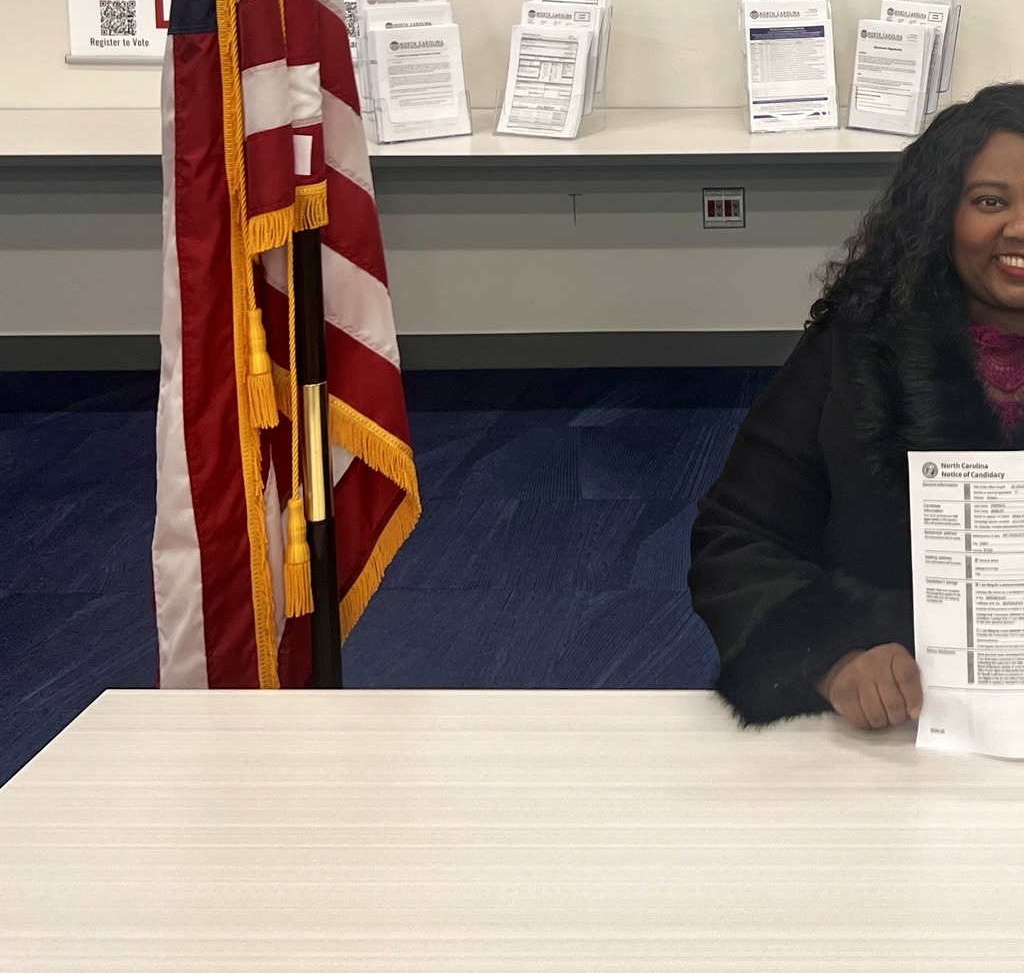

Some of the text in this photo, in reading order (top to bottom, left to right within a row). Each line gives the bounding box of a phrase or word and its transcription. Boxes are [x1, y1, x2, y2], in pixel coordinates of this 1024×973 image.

[90, 38, 120, 48] Register
[132, 38, 149, 47] Vote
[971, 471, 1005, 479] Candidacy
